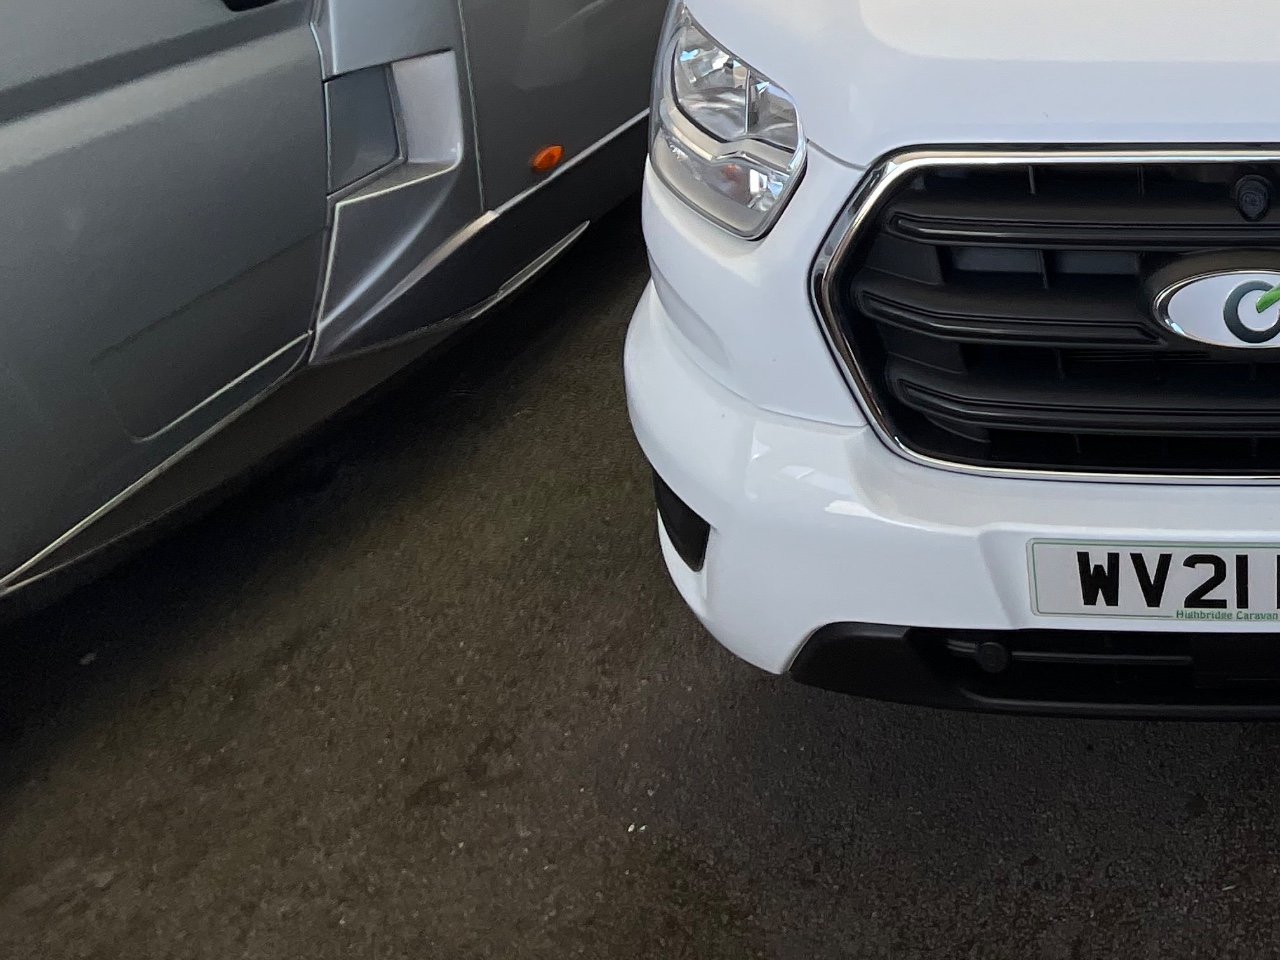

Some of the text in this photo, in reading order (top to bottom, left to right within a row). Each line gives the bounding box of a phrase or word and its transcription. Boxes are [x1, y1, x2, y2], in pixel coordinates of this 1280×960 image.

[1077, 551, 1249, 609] WV21
[1175, 610, 1233, 621] Highbridge
[1236, 610, 1279, 620] Caravan
